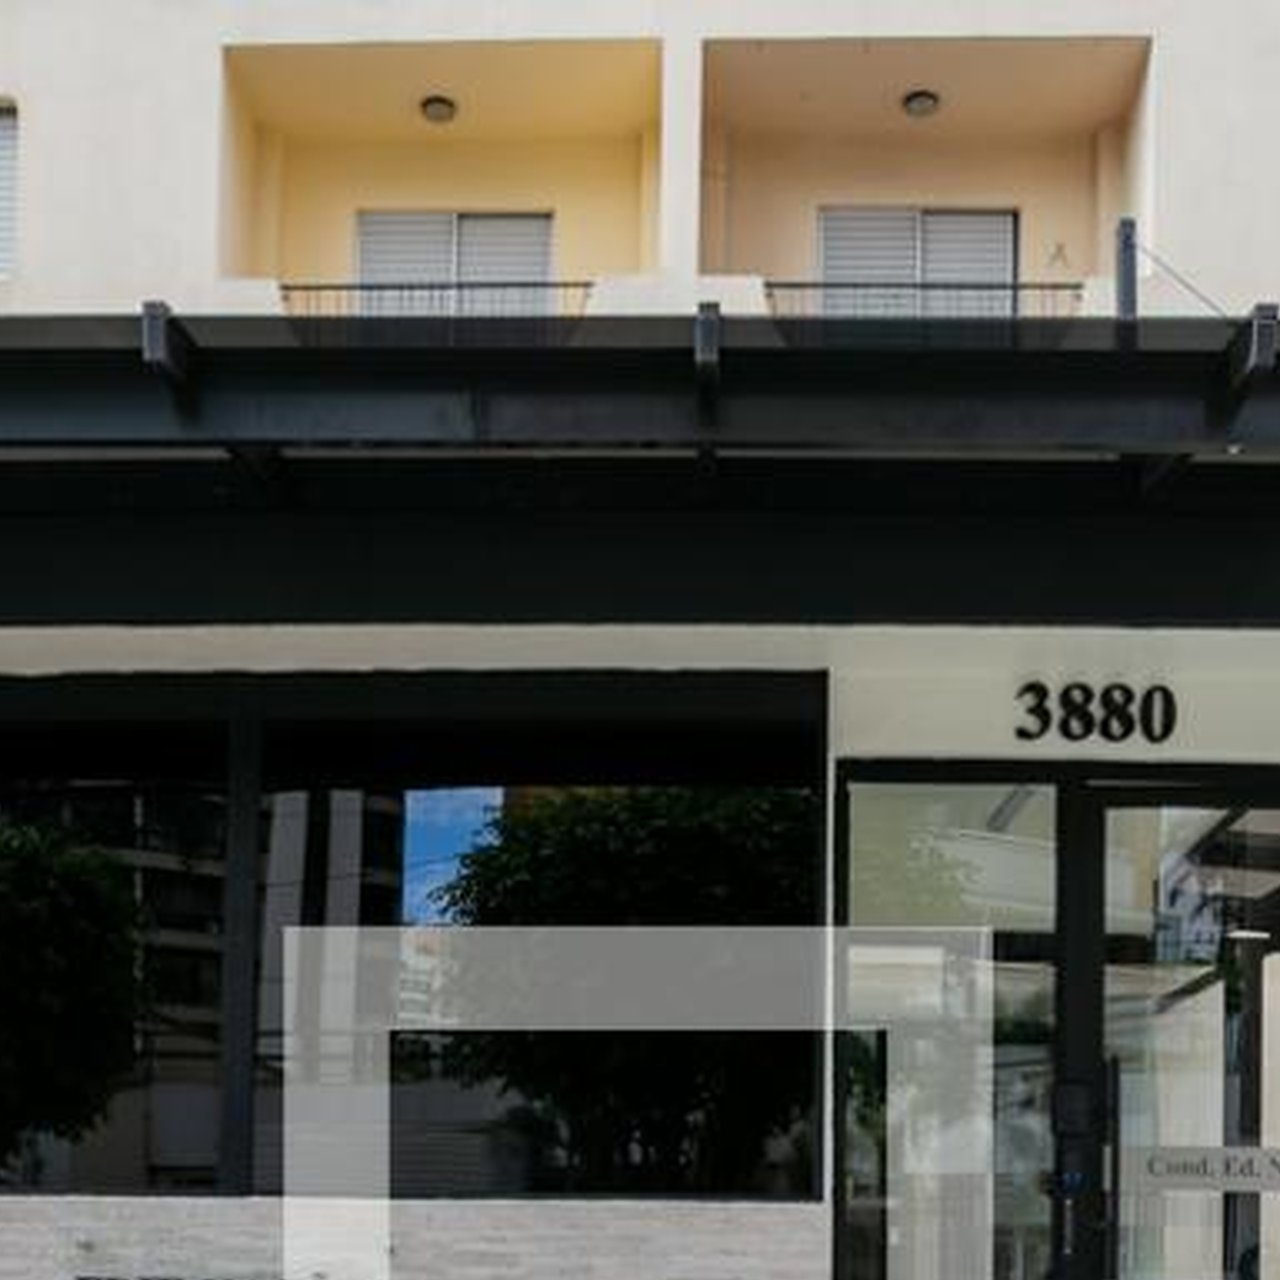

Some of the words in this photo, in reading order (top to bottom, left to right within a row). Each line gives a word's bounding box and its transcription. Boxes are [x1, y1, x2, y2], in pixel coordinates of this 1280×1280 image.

[1014, 681, 1177, 743] 3880
[1147, 1155, 1215, 1178] Cond.
[1223, 1155, 1261, 1178] Ed.
